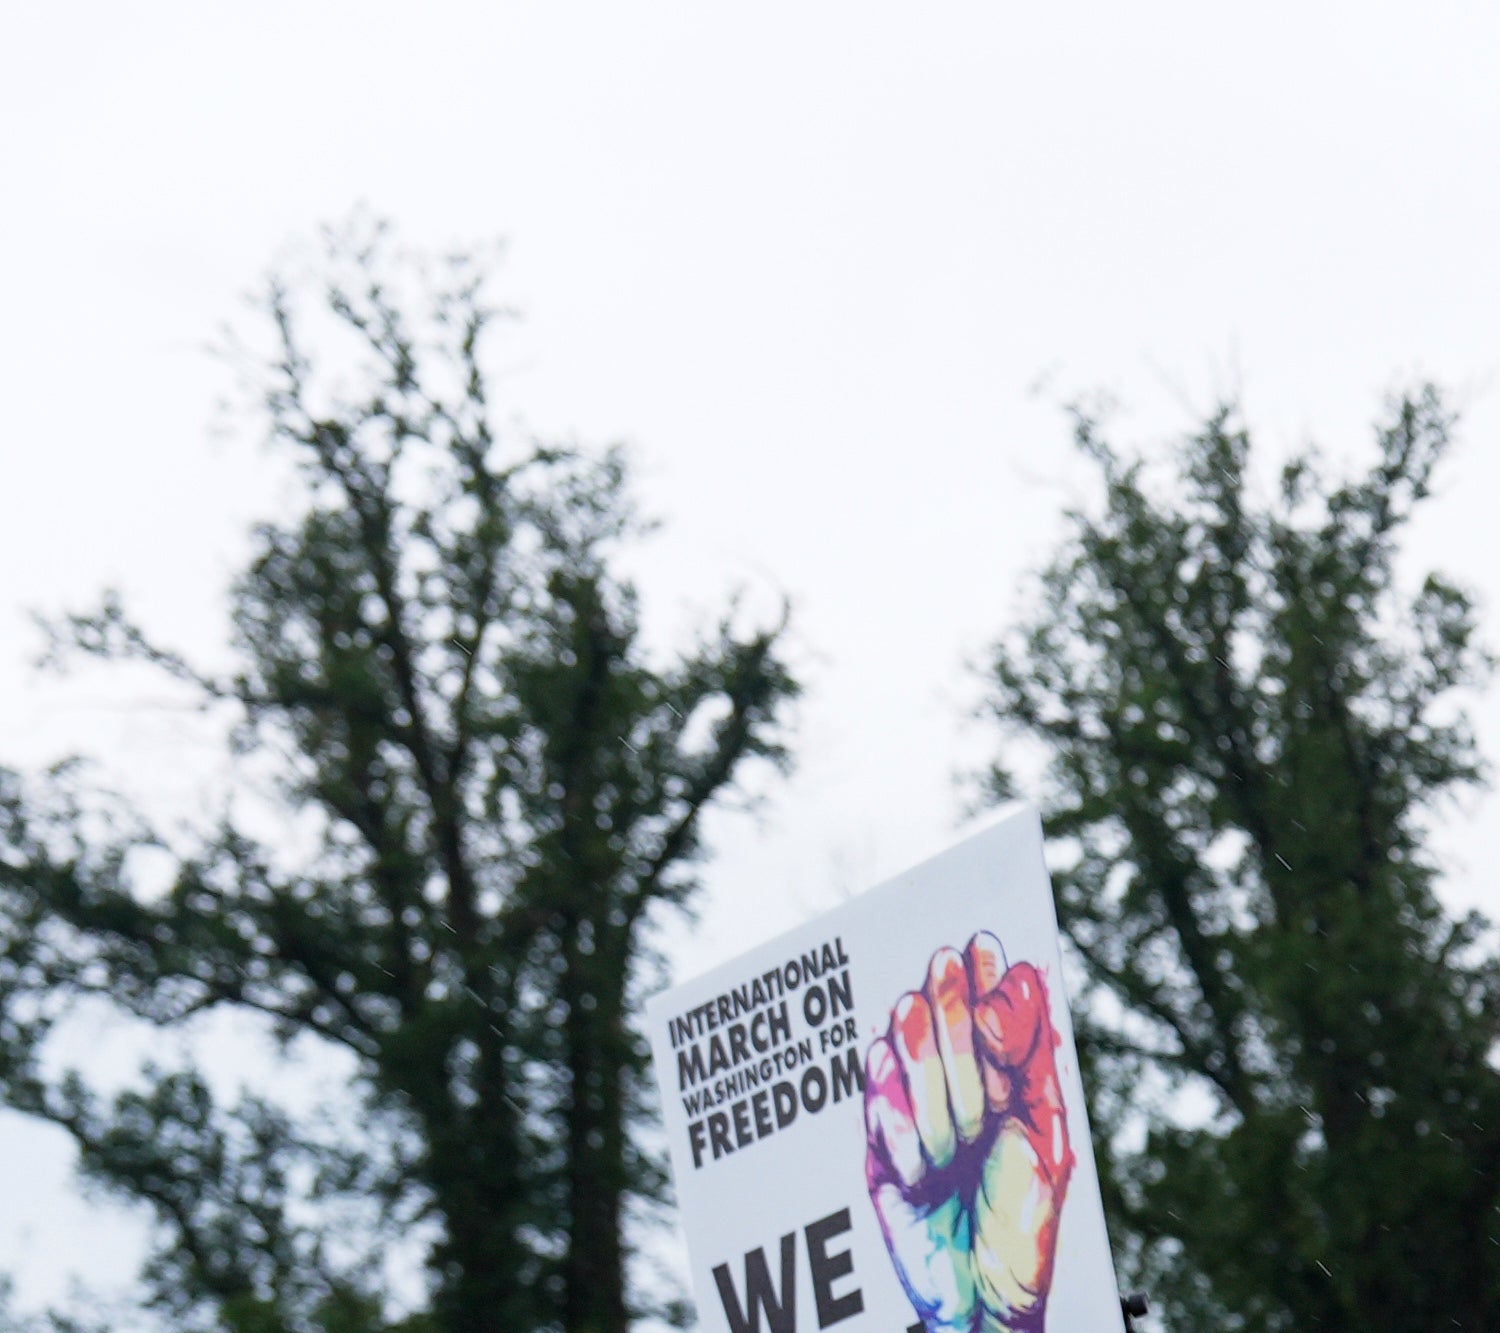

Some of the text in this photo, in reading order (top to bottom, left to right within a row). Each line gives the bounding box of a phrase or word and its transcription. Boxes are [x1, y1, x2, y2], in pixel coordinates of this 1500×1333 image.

[667, 937, 849, 1049] INTERNATIONAL
[677, 969, 855, 1092] MARCH ON
[681, 1016, 858, 1118] WASHINGTON FOR
[687, 1046, 866, 1170] FREEDOM
